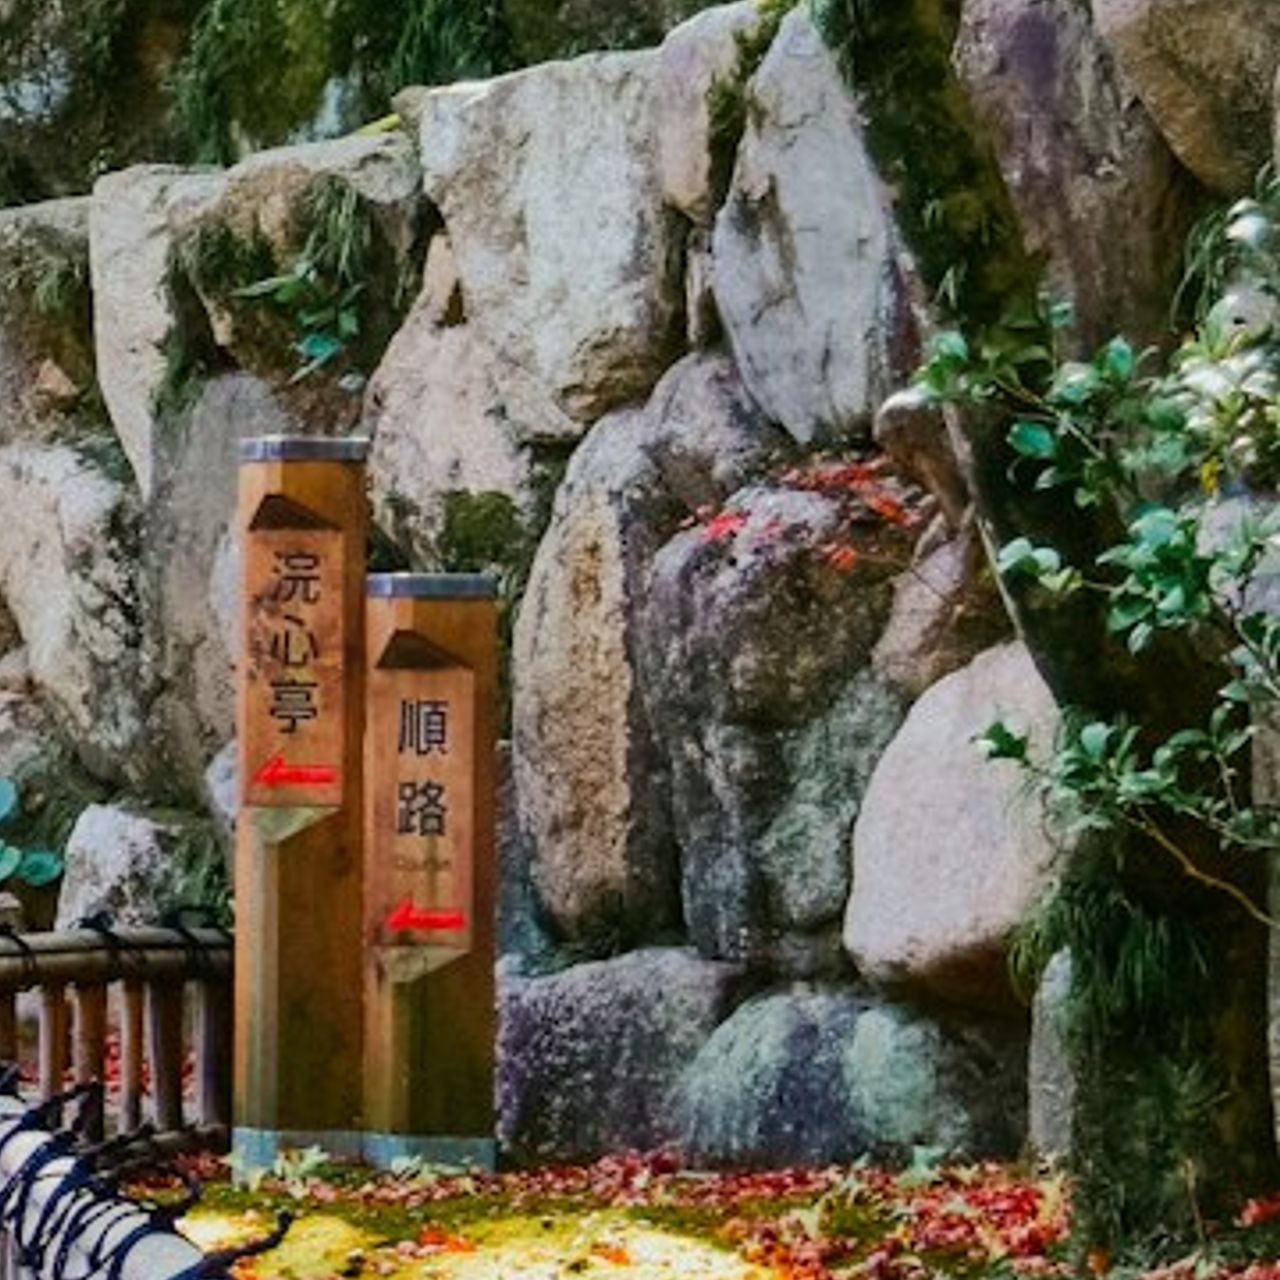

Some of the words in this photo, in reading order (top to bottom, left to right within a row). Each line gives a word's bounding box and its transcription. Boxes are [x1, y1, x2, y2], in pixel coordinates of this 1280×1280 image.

[270, 549, 321, 733] 浣心亭
[397, 699, 449, 837] 順路
